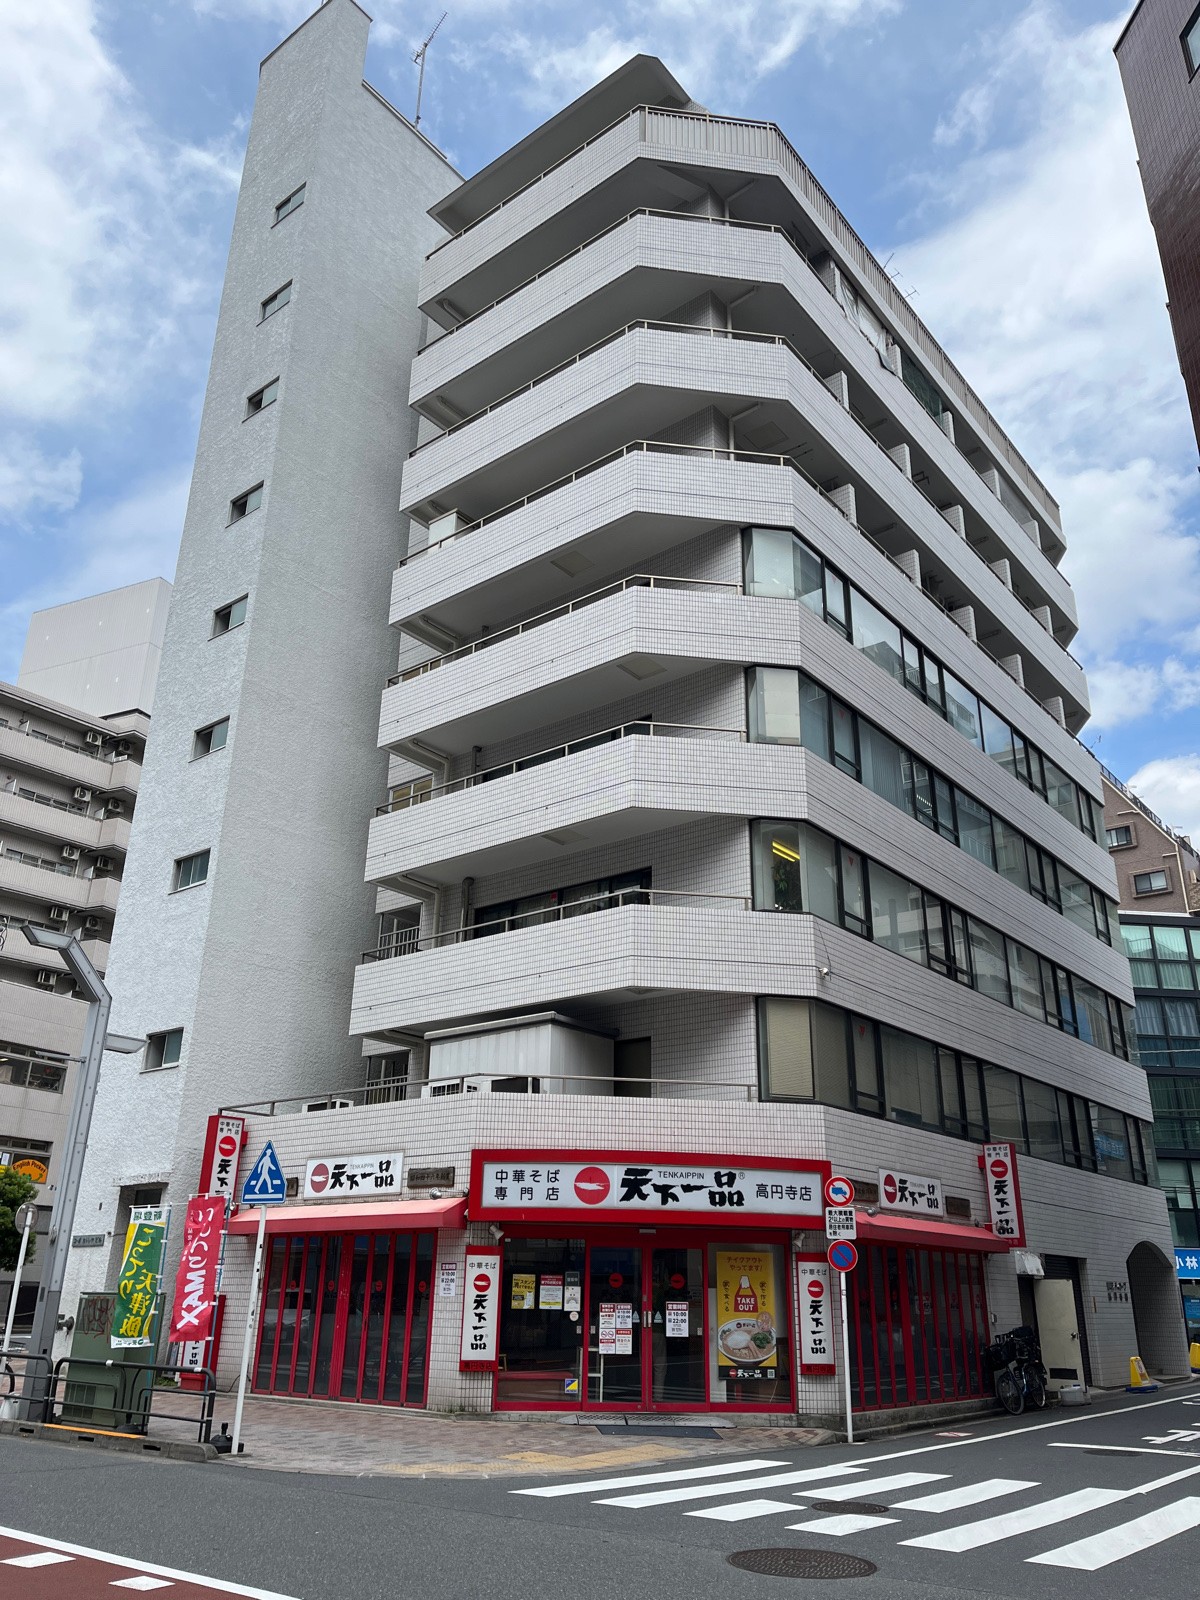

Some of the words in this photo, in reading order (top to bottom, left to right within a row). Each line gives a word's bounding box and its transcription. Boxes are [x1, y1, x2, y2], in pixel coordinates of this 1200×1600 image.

[219, 1127, 240, 1135] 専門店
[220, 1121, 241, 1129] 中華そば
[329, 1159, 395, 1190] 天下一品
[495, 1169, 561, 1184] 中華そば
[657, 1170, 705, 1180] TENKAIPPIN
[494, 1186, 560, 1201] 専門店
[619, 1167, 745, 1207] 天下一品
[755, 1183, 812, 1202] 高円寺店
[898, 1178, 939, 1209] 天下一品
[994, 1180, 1015, 1235] 天下一品
[468, 1262, 497, 1270] 中華そば
[727, 1256, 763, 1264] テイクアウト
[1176, 1255, 1200, 1270] 小林
[801, 1268, 828, 1276] 中華そば
[470, 1293, 489, 1351] 天下一品
[809, 1299, 827, 1355] 天下一品
[737, 1369, 762, 1378] 天下一品
